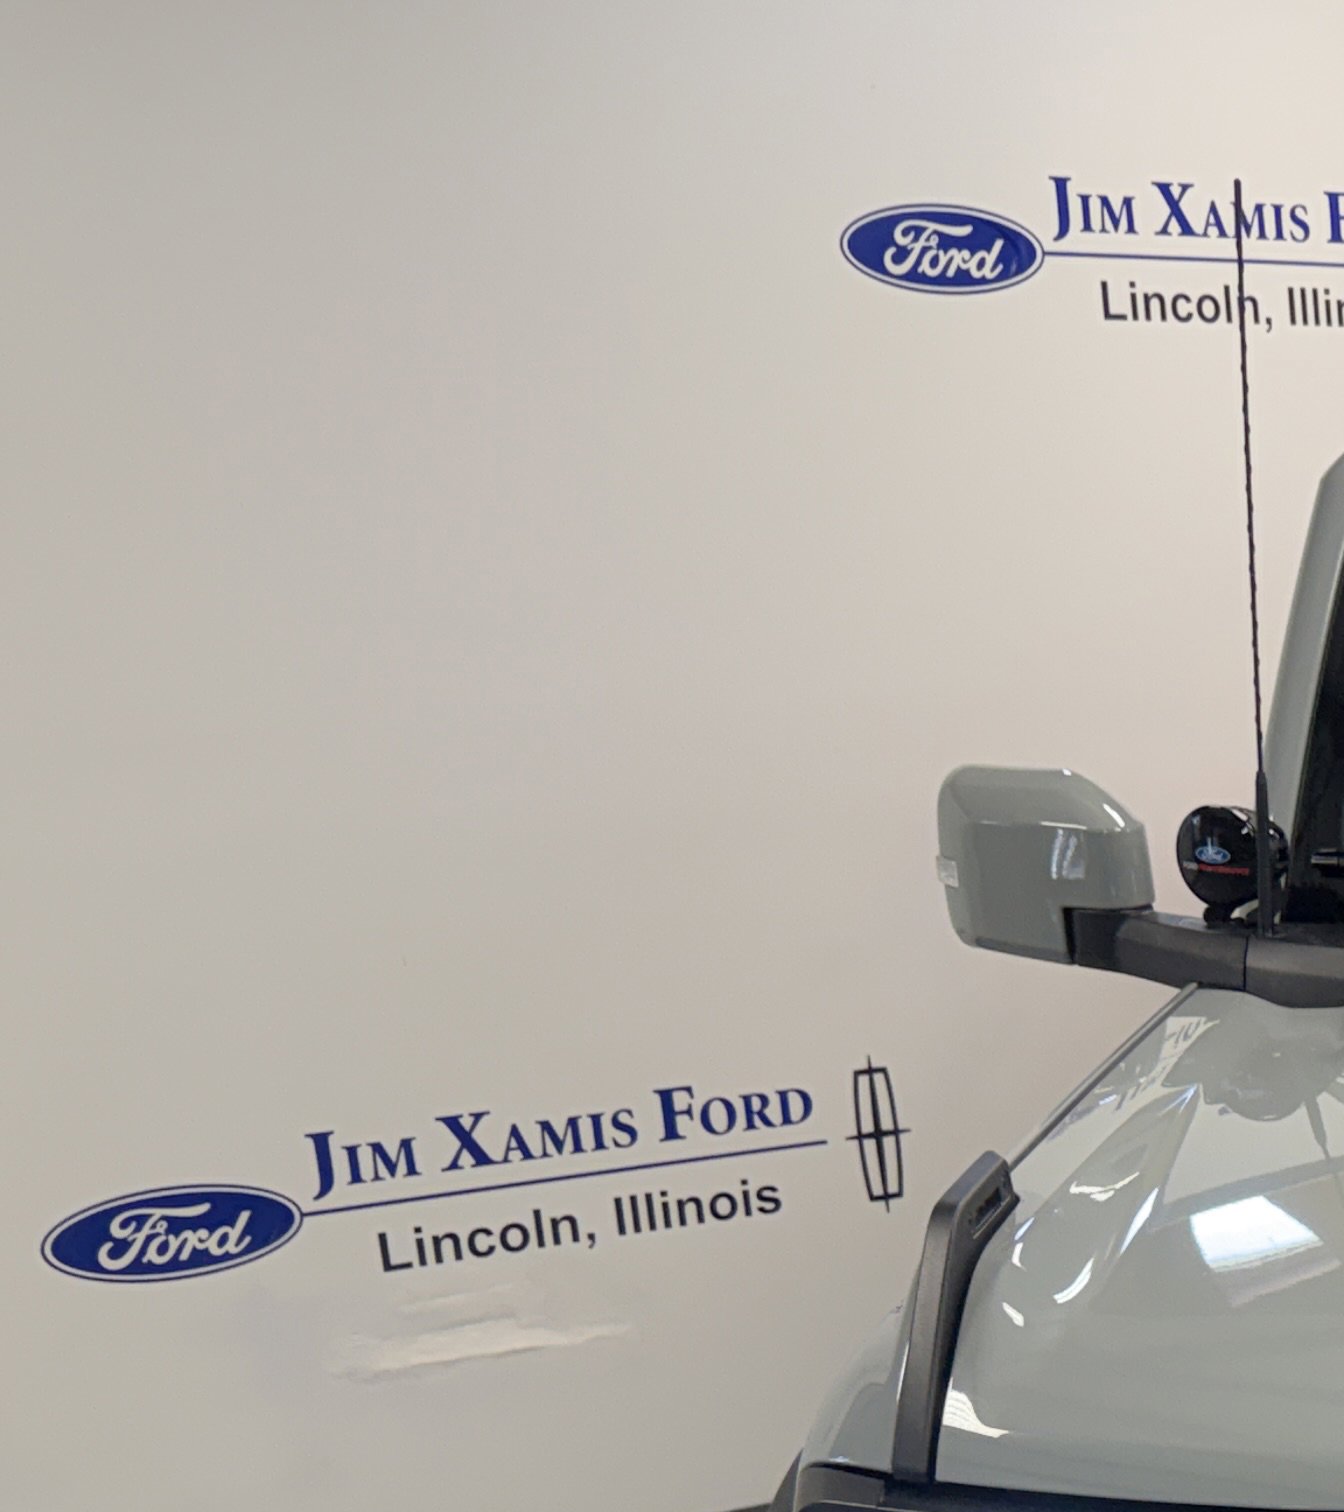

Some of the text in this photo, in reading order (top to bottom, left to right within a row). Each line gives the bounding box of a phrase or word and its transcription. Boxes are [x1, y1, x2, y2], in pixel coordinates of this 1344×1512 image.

[1049, 176, 1137, 242] JIM
[1151, 181, 1310, 244] XAMIS
[883, 217, 1005, 281] Ford
[1100, 280, 1272, 333] Lincoln,
[304, 1086, 816, 1202] JIM XAMIS FORD
[98, 1202, 251, 1271] Ford
[377, 1179, 783, 1273] Lincoln, Illinois
